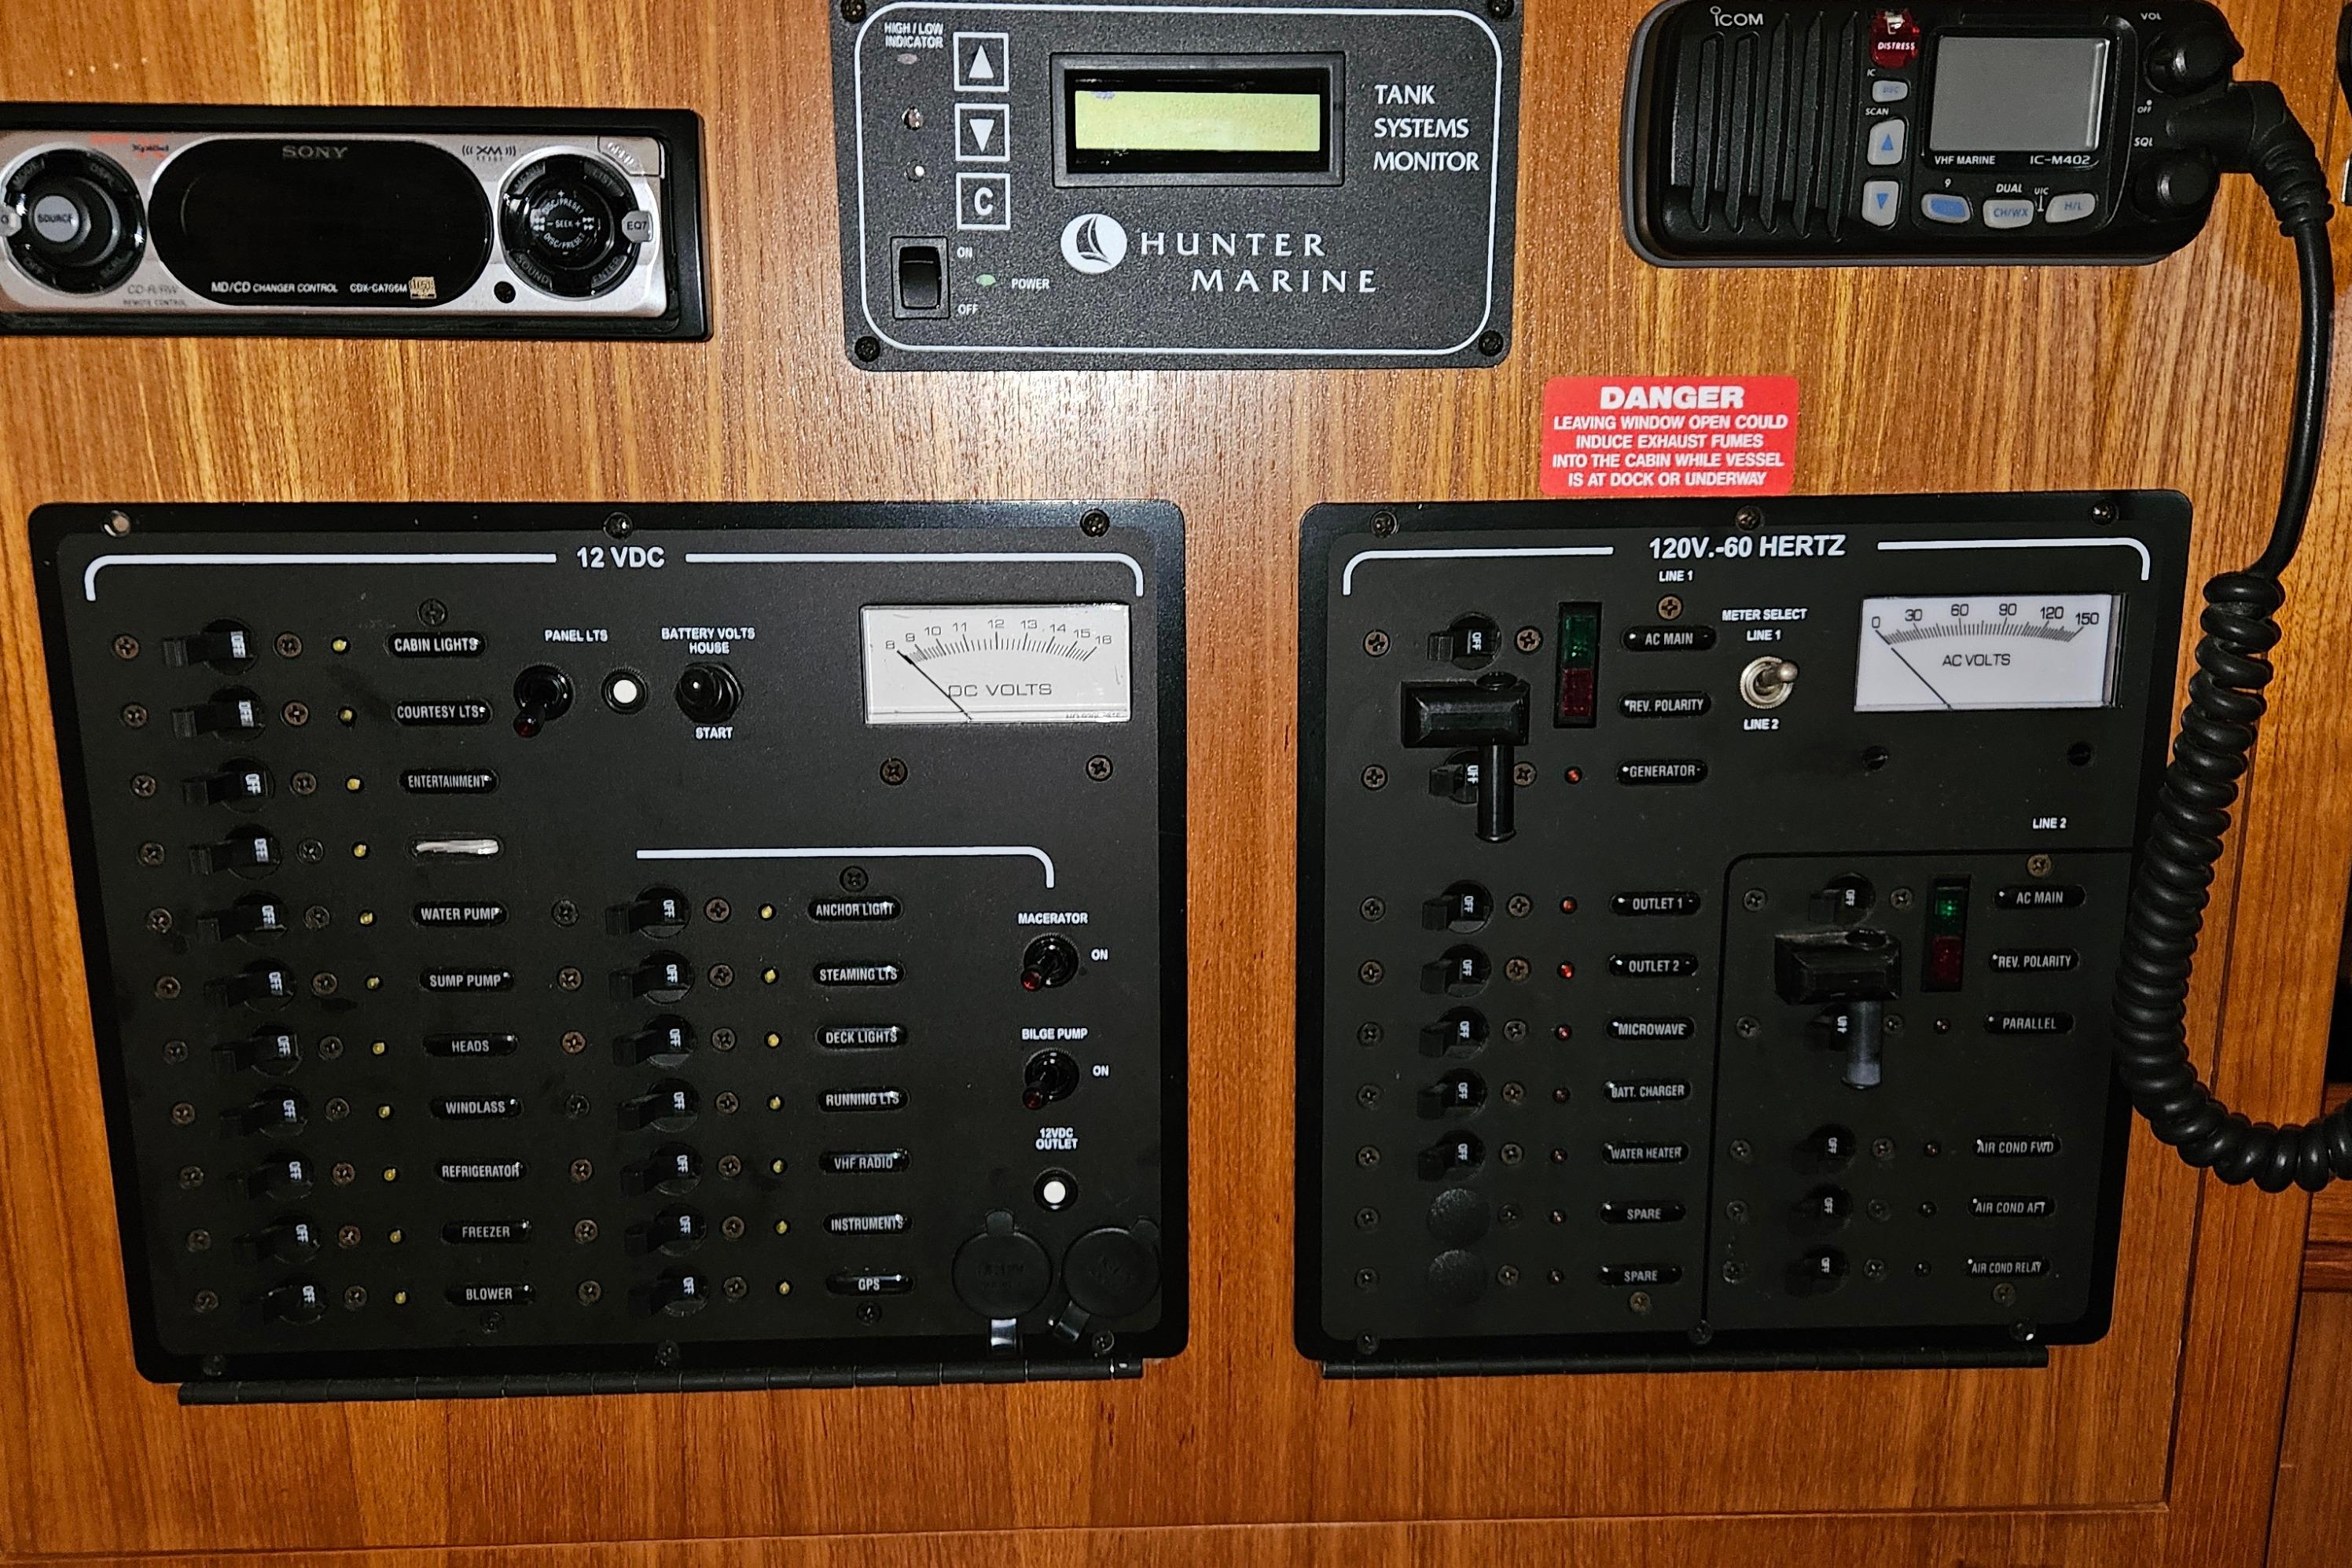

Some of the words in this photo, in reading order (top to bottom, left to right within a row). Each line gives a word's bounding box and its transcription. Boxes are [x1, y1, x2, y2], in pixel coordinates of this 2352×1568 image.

[2141, 13, 2162, 21] VOL
[884, 22, 910, 35] HIGH
[918, 22, 943, 35] LOW
[885, 35, 943, 49] INDICATOR
[1877, 42, 1916, 50] DISTRESS
[1374, 84, 1436, 105] TANK
[1865, 107, 1890, 116] SCAN
[1373, 118, 1470, 139] SYSTEMS
[2133, 137, 2153, 148] SQL
[282, 145, 348, 159] SONY
[1373, 151, 1480, 172] MONITOR
[1935, 156, 1956, 165] VHF
[1957, 155, 1996, 166] MARINE
[2030, 155, 2091, 166] IC-M402
[1995, 183, 2023, 194] DUAL
[974, 186, 994, 216] C
[1993, 206, 2029, 218] CH/WX
[626, 220, 647, 231] EQ7
[1140, 232, 1326, 257] HUNTER
[957, 247, 972, 259] ON
[211, 281, 251, 293] MD/CD
[252, 283, 296, 293] CHANGER
[297, 283, 339, 292] CONTROL
[1011, 278, 1049, 289] POWER
[1190, 270, 1376, 293] MARINE
[957, 303, 978, 315] OFF
[1600, 385, 1745, 410] DANGER
[1553, 416, 1616, 431] LEAVING
[1621, 415, 1685, 430] WINDOW
[1689, 414, 1731, 429] OPEN
[1735, 413, 1788, 429] COULD
[1575, 434, 1633, 449] INDUCE
[1637, 434, 1707, 448] EXHAUST
[1711, 433, 1764, 448] FUMES
[1553, 454, 1588, 468] INTO
[1590, 453, 1620, 468] THE
[1625, 453, 1671, 467] CABIN
[1675, 452, 1722, 467] WHILE
[1725, 451, 1785, 466] VESSEL
[1567, 473, 1584, 487] IS
[1587, 472, 1605, 487] AT
[1610, 472, 1655, 487] DOCK
[1658, 472, 1681, 486] OR
[1685, 471, 1768, 486] UNDERWAY
[1649, 535, 1753, 560] 120V.-60
[1758, 534, 1847, 557] HERTZ
[576, 546, 605, 568] 12
[609, 546, 665, 568] VDC
[1658, 571, 1685, 582] LINE
[1687, 570, 1694, 581] 1
[1722, 609, 1761, 621] METER
[1762, 608, 1808, 620] SELECT
[1904, 609, 1924, 622] 30
[1950, 604, 1970, 617] 60
[1998, 603, 2018, 616] 90
[2039, 606, 2065, 620] 120
[987, 619, 1005, 630] 12
[1020, 619, 1038, 630] 13
[1871, 616, 1881, 629] 0
[2075, 611, 2100, 626] 150
[661, 627, 715, 641] BATTERY
[717, 626, 755, 640] VOLTS
[924, 626, 942, 636] 10
[952, 622, 968, 633] 11
[1049, 623, 1067, 633] 14
[1073, 628, 1091, 638] 15
[544, 629, 584, 642] PANEL
[586, 629, 608, 642] LTS
[1471, 630, 1483, 652] OFF
[1645, 633, 1660, 646] AC
[1663, 632, 1693, 644] MAIN
[1747, 630, 1773, 641] LINE
[1774, 630, 1781, 641] 1
[394, 637, 431, 652] CABIN
[433, 637, 478, 652] LIGHTS
[689, 641, 730, 655] HOUSE
[1942, 655, 1962, 667] AC
[1965, 653, 2011, 666] VOLTS
[948, 685, 978, 697] DC
[986, 683, 1053, 696] VOLTS
[396, 704, 455, 719] COURTESY
[1629, 700, 1652, 713] REV.
[1654, 699, 1705, 712] POLARITY
[1743, 719, 1770, 731] LINE
[1771, 718, 1780, 730] 2
[695, 726, 733, 740] START
[1629, 765, 1696, 778] GENERATOR
[407, 773, 487, 788] ENTERTAINMENT
[2032, 817, 2058, 830] LINE
[2060, 817, 2067, 829] 2
[1464, 895, 1474, 914] OFF
[1632, 898, 1674, 911] OUTLET
[1677, 898, 1683, 909] 1
[2016, 892, 2032, 905] AC
[2034, 890, 2064, 904] MAIN
[421, 907, 461, 921] WATER
[464, 906, 498, 920] PUMP
[663, 899, 675, 919] OFF
[815, 903, 860, 917] ANCHOR
[862, 901, 894, 916] LIGHT
[1018, 912, 1089, 925] MACERATOR
[1091, 949, 1108, 961] ON
[1997, 956, 2020, 968] REV.
[2023, 955, 2072, 968] POLARITY
[1628, 960, 1670, 973] OUTLET
[1672, 959, 1679, 971] 2
[428, 974, 464, 988] SUMP
[468, 974, 502, 988] PUMP
[819, 968, 876, 982] STEAMING
[878, 967, 898, 980] LTS
[1617, 1023, 1685, 1037] MICROWAVE
[2002, 1017, 2057, 1030] PARALLEL
[825, 1031, 855, 1045] DECK
[857, 1030, 898, 1044] LIGHTS
[1021, 1028, 1055, 1041] BILGE
[1057, 1028, 1089, 1040] PUMP
[451, 1039, 490, 1052] HEADS
[1093, 1065, 1109, 1077] ON
[1611, 1086, 1637, 1099] BATT.
[1639, 1085, 1685, 1098] CHARGER
[673, 1091, 686, 1111] OFF
[825, 1093, 877, 1107] RUNNING
[880, 1092, 900, 1105] LTS
[445, 1100, 506, 1114] WINDLASS
[1039, 1127, 1074, 1140] 12VDC
[1035, 1138, 1079, 1151] OUTLET
[1977, 1141, 1996, 1155] AIR
[1998, 1140, 2027, 1154] COND
[2030, 1140, 2054, 1153] FWD
[1610, 1148, 1644, 1160] WATER
[1645, 1146, 1682, 1159] HEATER
[833, 1157, 857, 1170] VHF
[858, 1156, 894, 1170] RADIO
[441, 1163, 520, 1179] REFRIGERATOR
[1626, 1208, 1662, 1221] SPARE
[1975, 1202, 1994, 1214] AIR
[1996, 1202, 2025, 1214] COND
[2026, 1201, 2046, 1214] AFT
[679, 1215, 692, 1235] OFF
[830, 1217, 904, 1231] INSTRUMENTS
[461, 1225, 510, 1239] FREEZER
[1971, 1262, 1988, 1275] AIR
[1989, 1261, 2014, 1274] COND
[2015, 1261, 2043, 1273] RELAY
[1623, 1270, 1659, 1283] SPARE
[857, 1279, 880, 1291] GPS
[465, 1287, 513, 1301] BLOWER
